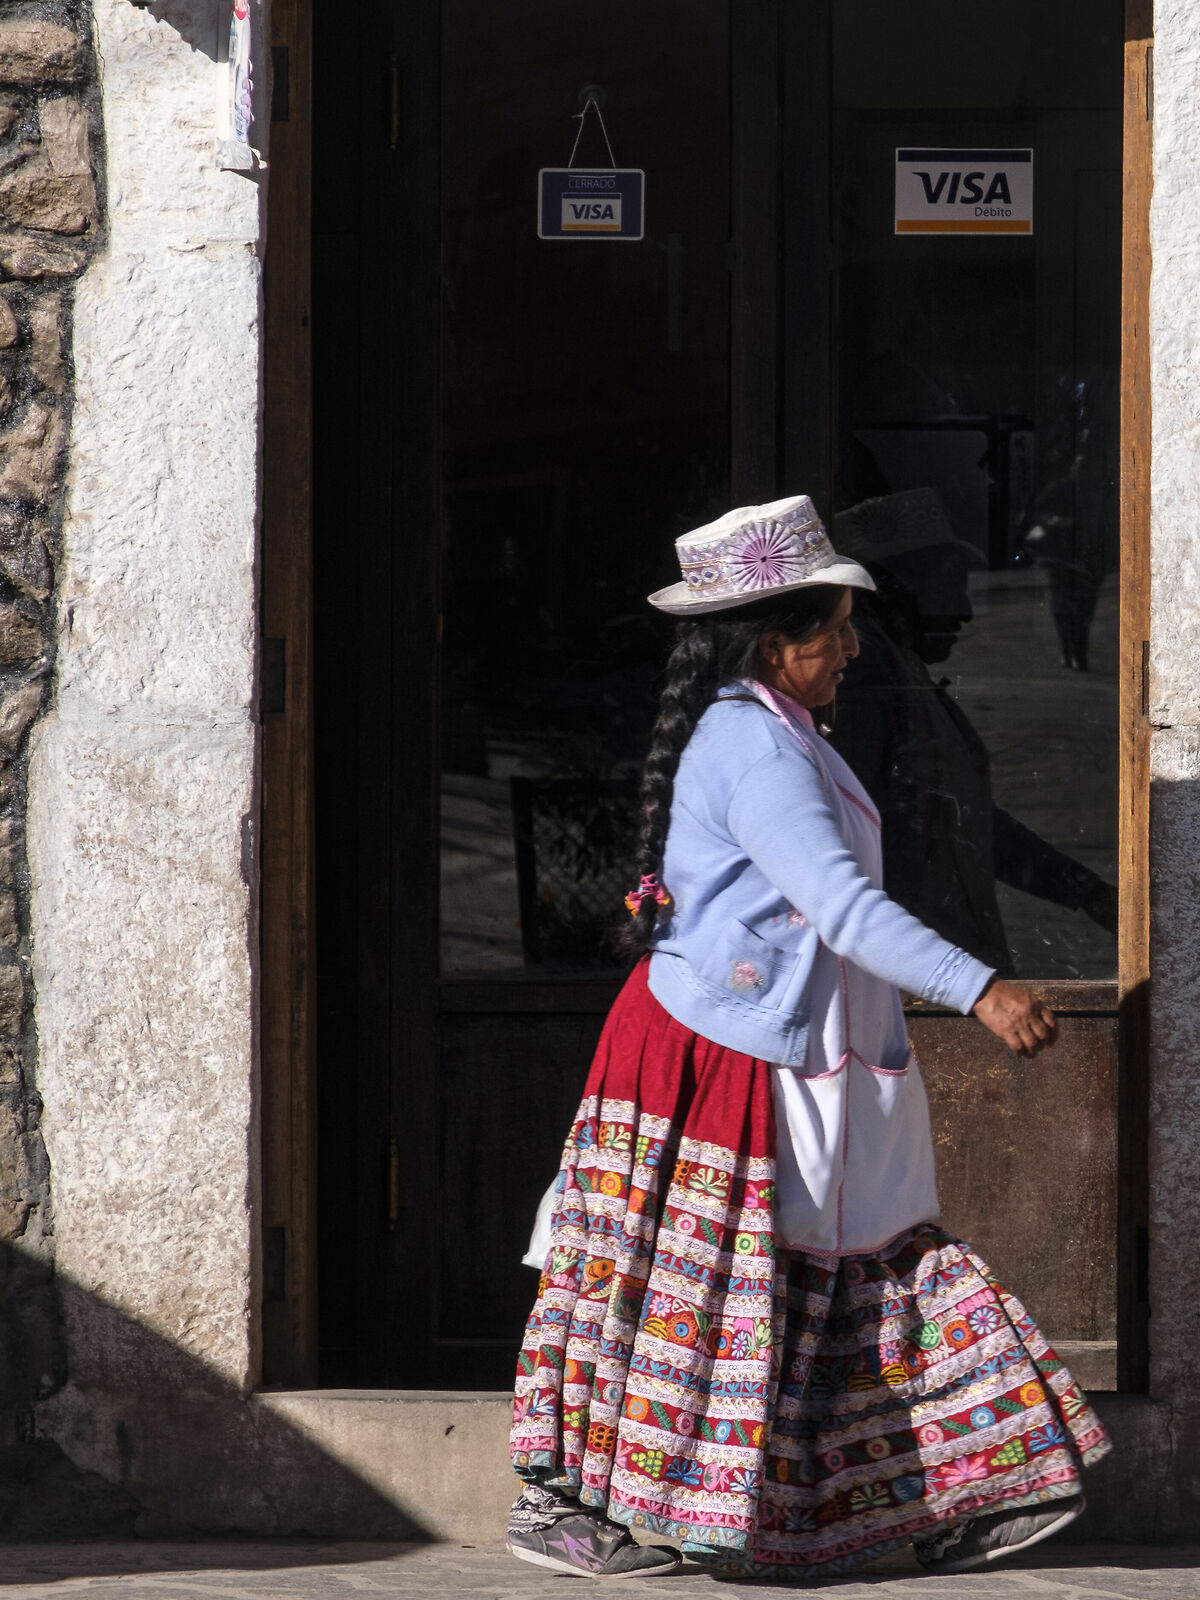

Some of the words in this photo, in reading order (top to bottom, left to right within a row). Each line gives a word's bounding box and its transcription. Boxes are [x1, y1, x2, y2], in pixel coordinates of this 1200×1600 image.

[568, 178, 616, 189] CERRADO
[912, 171, 1012, 204] VISA
[568, 203, 614, 220] VISA
